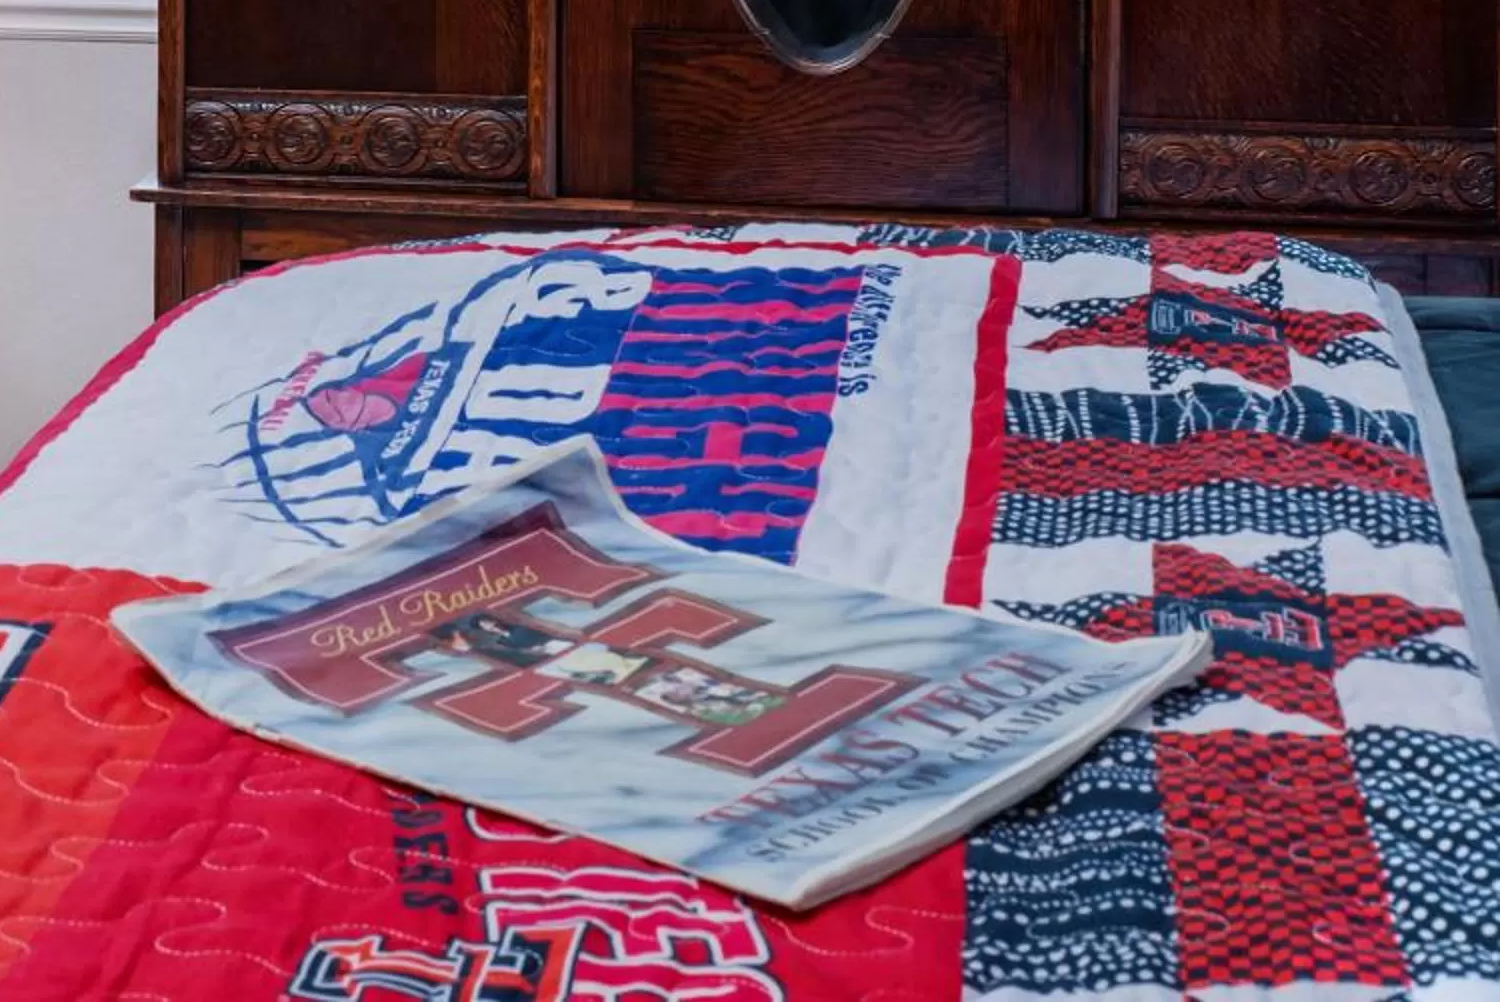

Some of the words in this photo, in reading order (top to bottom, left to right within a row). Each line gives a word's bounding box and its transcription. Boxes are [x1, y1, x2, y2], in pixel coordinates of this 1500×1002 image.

[407, 359, 450, 416] TEXAS
[310, 604, 402, 659] Red
[400, 565, 540, 627] Raiders
[696, 728, 921, 830] TEXAS
[884, 650, 1073, 737] TECH
[745, 795, 896, 863] SCHOOL
